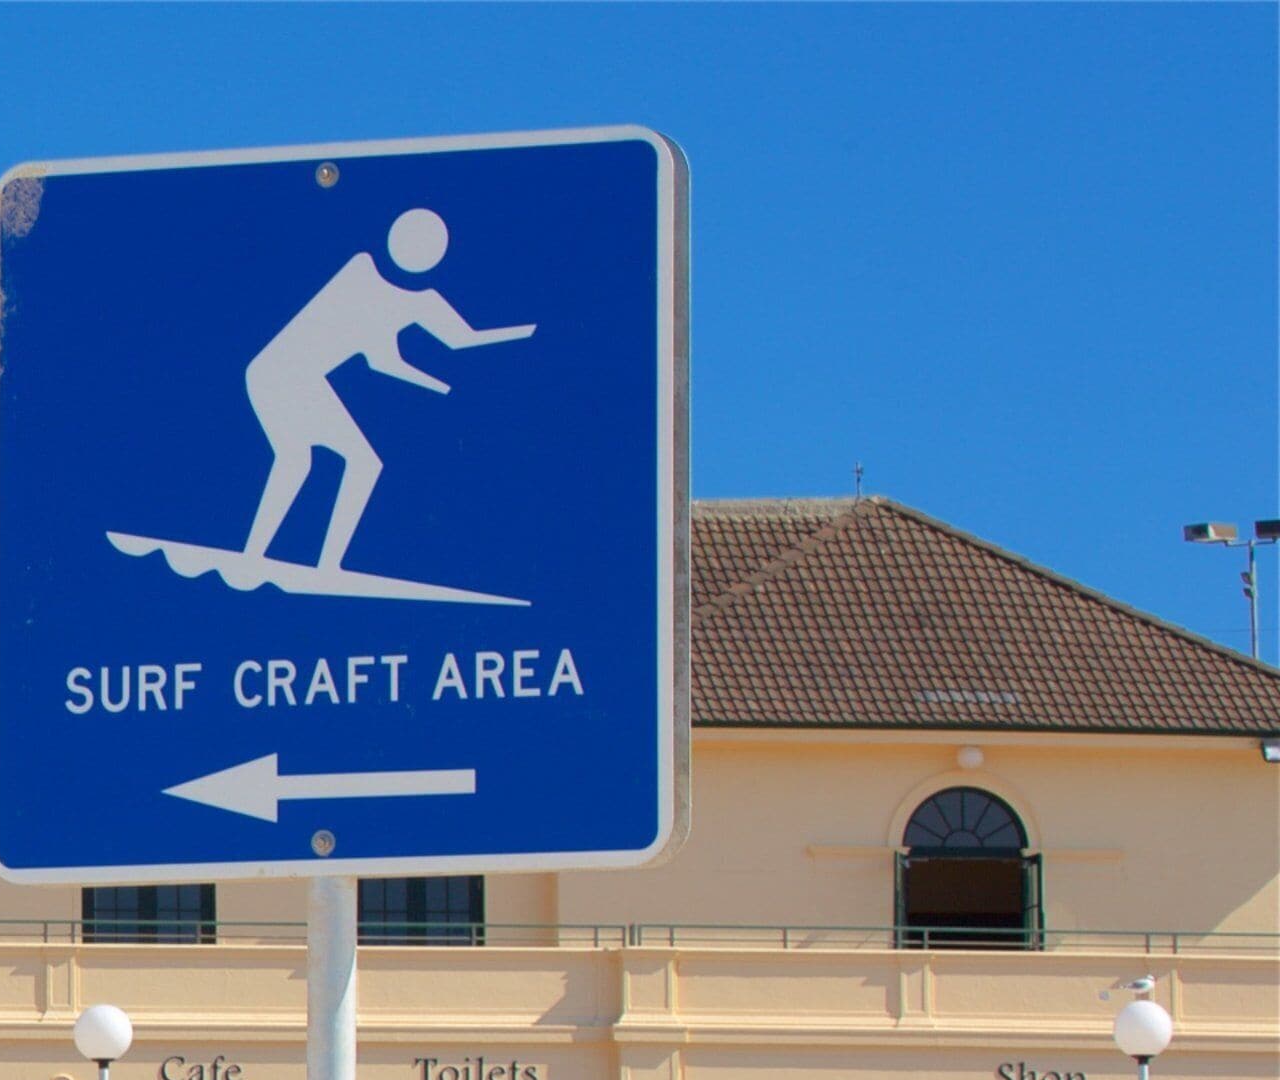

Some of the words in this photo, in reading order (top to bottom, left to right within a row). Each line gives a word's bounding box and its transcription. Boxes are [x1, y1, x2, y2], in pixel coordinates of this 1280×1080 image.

[64, 662, 203, 715] SURF
[233, 653, 409, 709] CRAFT
[432, 648, 586, 701] AREA
